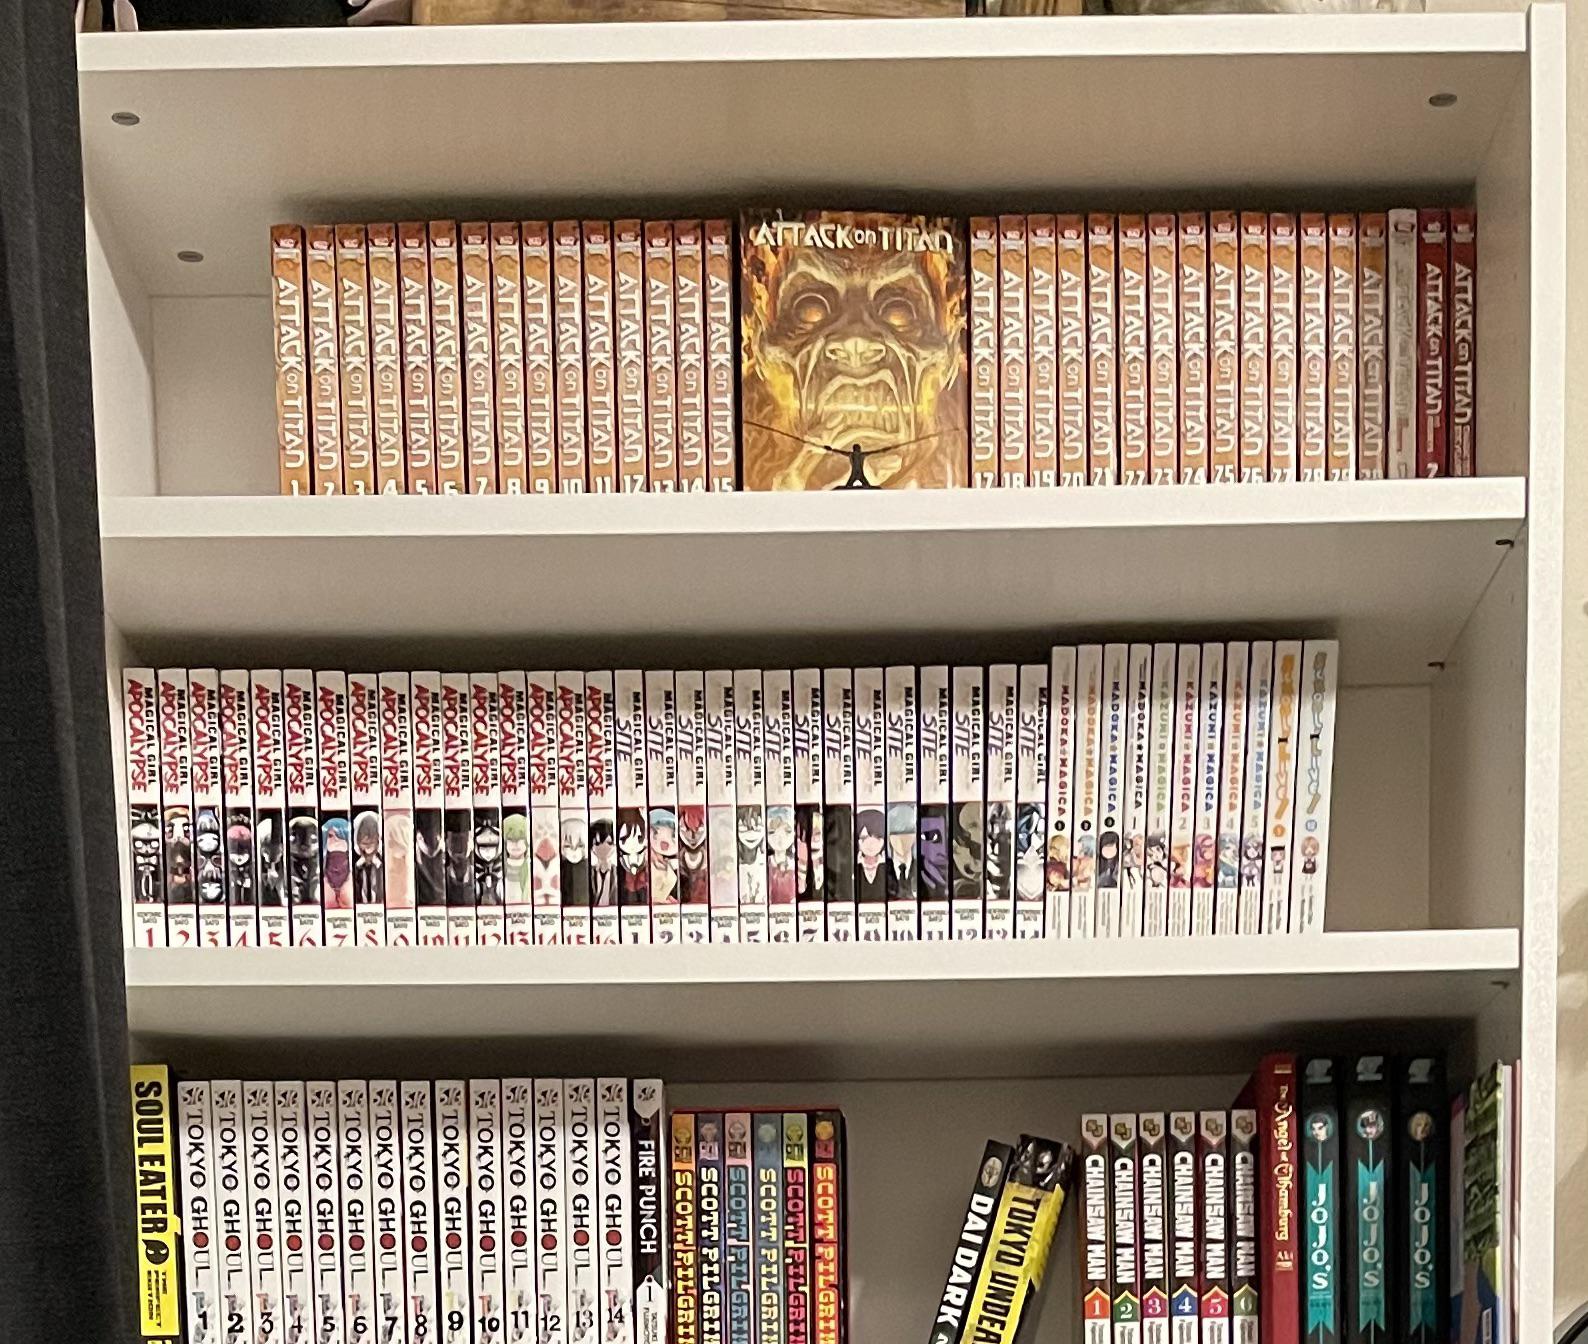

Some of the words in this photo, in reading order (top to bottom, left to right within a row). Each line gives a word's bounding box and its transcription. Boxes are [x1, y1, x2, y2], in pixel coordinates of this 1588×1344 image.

[754, 222, 854, 249] ATTACK
[854, 231, 876, 246] on
[879, 230, 954, 254] TITAN
[277, 277, 302, 373] ATTACK
[972, 268, 995, 364] ATTACK
[286, 373, 298, 394] on
[979, 364, 990, 385] on
[282, 395, 305, 468] TITAN
[974, 389, 995, 460] TITAN
[291, 481, 299, 495] 1
[976, 473, 993, 488] 17
[127, 679, 147, 793] APOCALYPSE
[144, 687, 155, 747] MAGICAL
[648, 716, 664, 761] SITE
[663, 690, 673, 751] MAGICAL
[147, 753, 158, 783] GIRL
[666, 758, 675, 787] GIRL
[144, 927, 154, 946] 1
[659, 929, 673, 943] 2
[134, 1081, 163, 1148] SOUL
[218, 1113, 239, 1193] TOKYO
[442, 1110, 460, 1189] TOKYO
[638, 1140, 655, 1179] FIRE
[137, 1153, 168, 1234] EATER
[639, 1184, 658, 1254] PUNCH
[701, 1167, 719, 1241] SCOTT
[816, 1166, 834, 1242] SCOTT
[960, 1194, 995, 1244] DAI
[1085, 1154, 1105, 1239] CHAINSAW
[1174, 1152, 1194, 1238] CHAINSAW
[223, 1200, 242, 1293] GHOUL
[444, 1197, 462, 1288] GHOUL
[999, 1195, 1040, 1269] TOKYO
[1087, 1244, 1106, 1279] MAN
[1175, 1242, 1194, 1277] MAN
[1311, 1183, 1331, 1289] JOJO'S
[645, 1286, 653, 1302] 1
[936, 1247, 980, 1327] DARK
[1091, 1298, 1101, 1315] 1
[1179, 1297, 1192, 1312] 4
[228, 1313, 244, 1333] 2
[448, 1311, 464, 1330] 9
